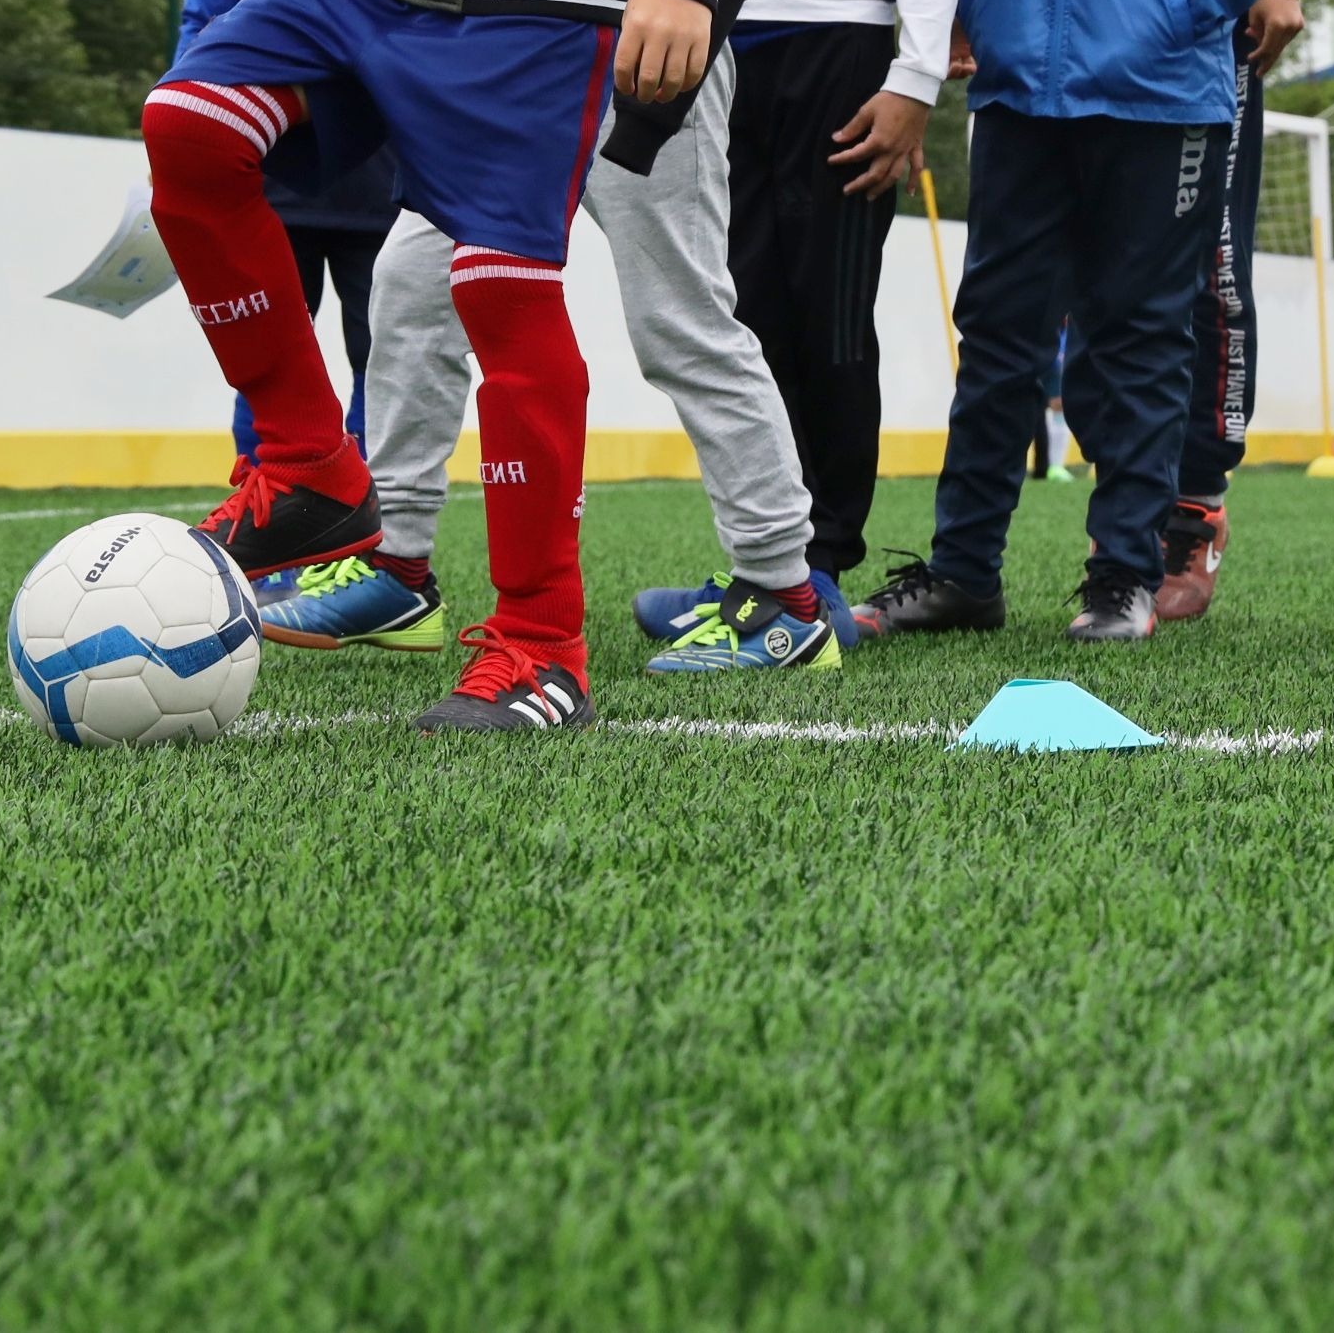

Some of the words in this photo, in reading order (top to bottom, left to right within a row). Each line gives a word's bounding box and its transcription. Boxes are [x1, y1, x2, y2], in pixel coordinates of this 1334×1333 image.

[1236, 64, 1249, 102] JUST
[1228, 328, 1245, 366] JUST
[1224, 369, 1246, 411] HAVE
[1224, 412, 1245, 443] FUN
